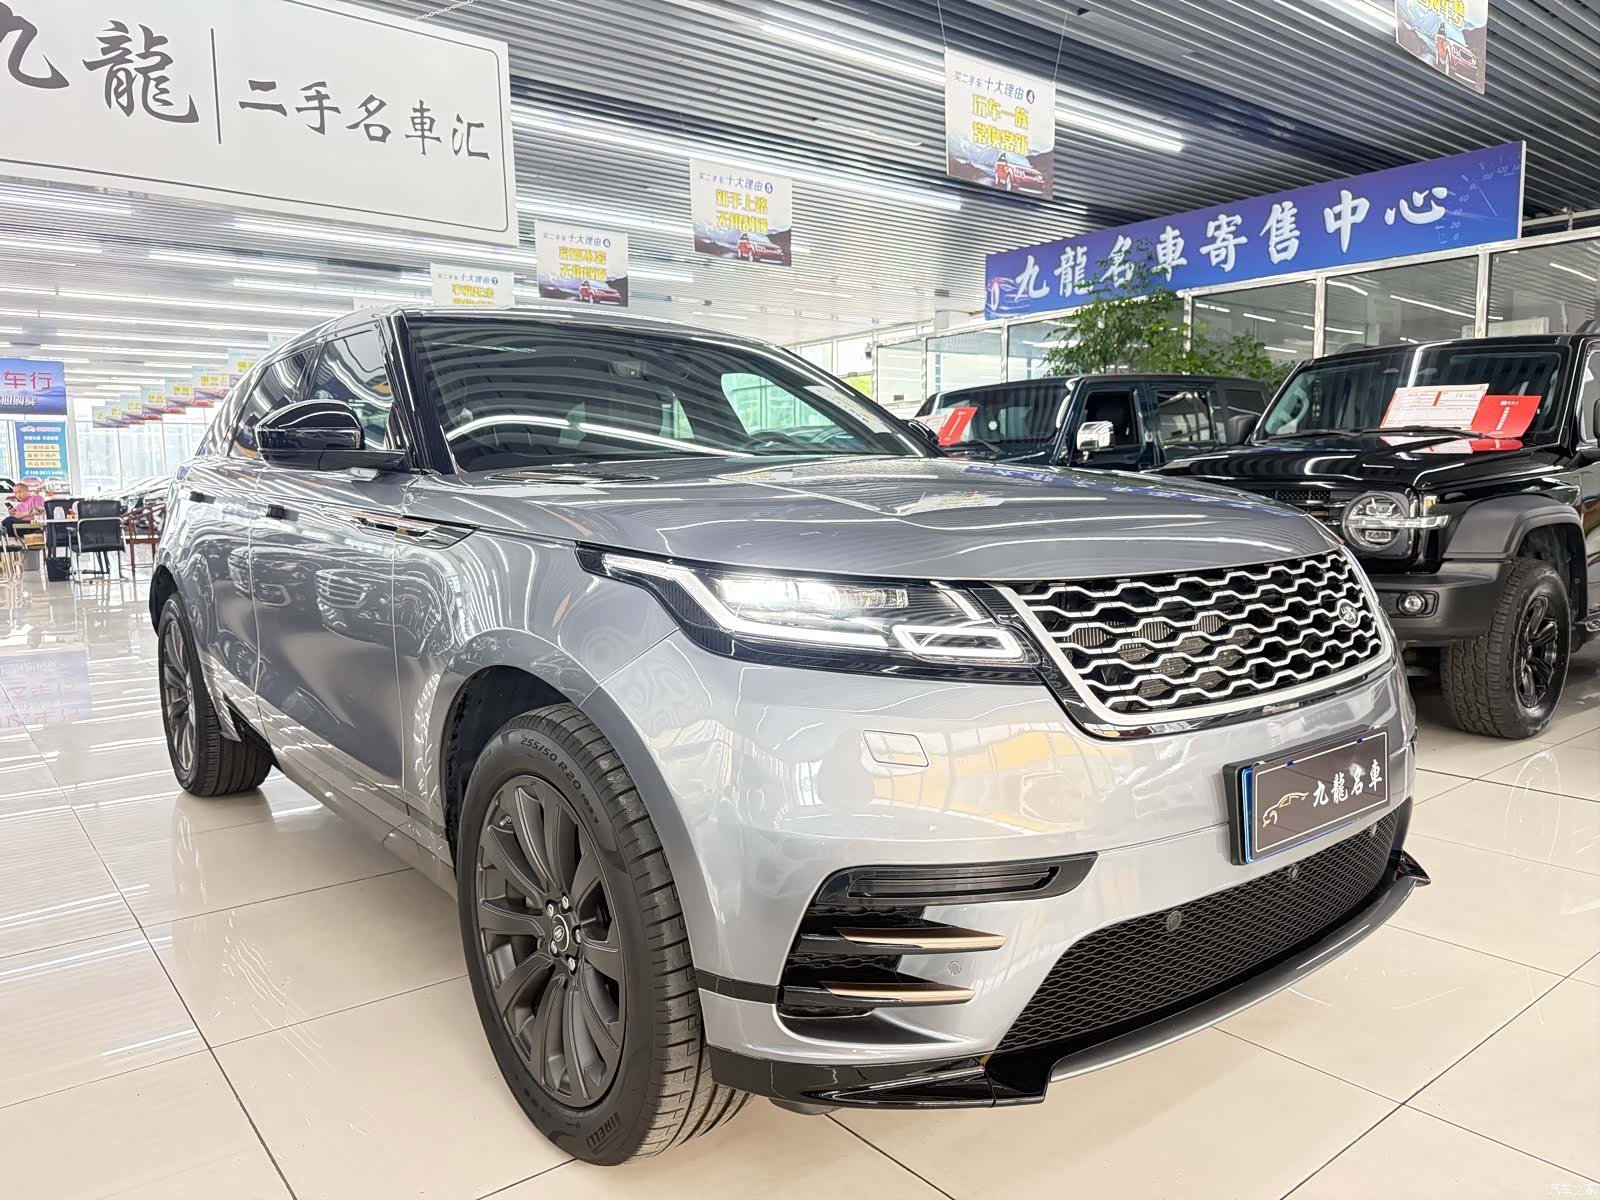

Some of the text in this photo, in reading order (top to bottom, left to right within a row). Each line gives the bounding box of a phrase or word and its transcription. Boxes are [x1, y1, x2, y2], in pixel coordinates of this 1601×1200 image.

[0, 2, 491, 161] 九龍 二手名車汇
[1014, 186, 1448, 303] 九龍名車寄售中心
[520, 736, 558, 762] 255/50
[557, 761, 582, 791] R20
[1312, 758, 1384, 808] 九龍名車
